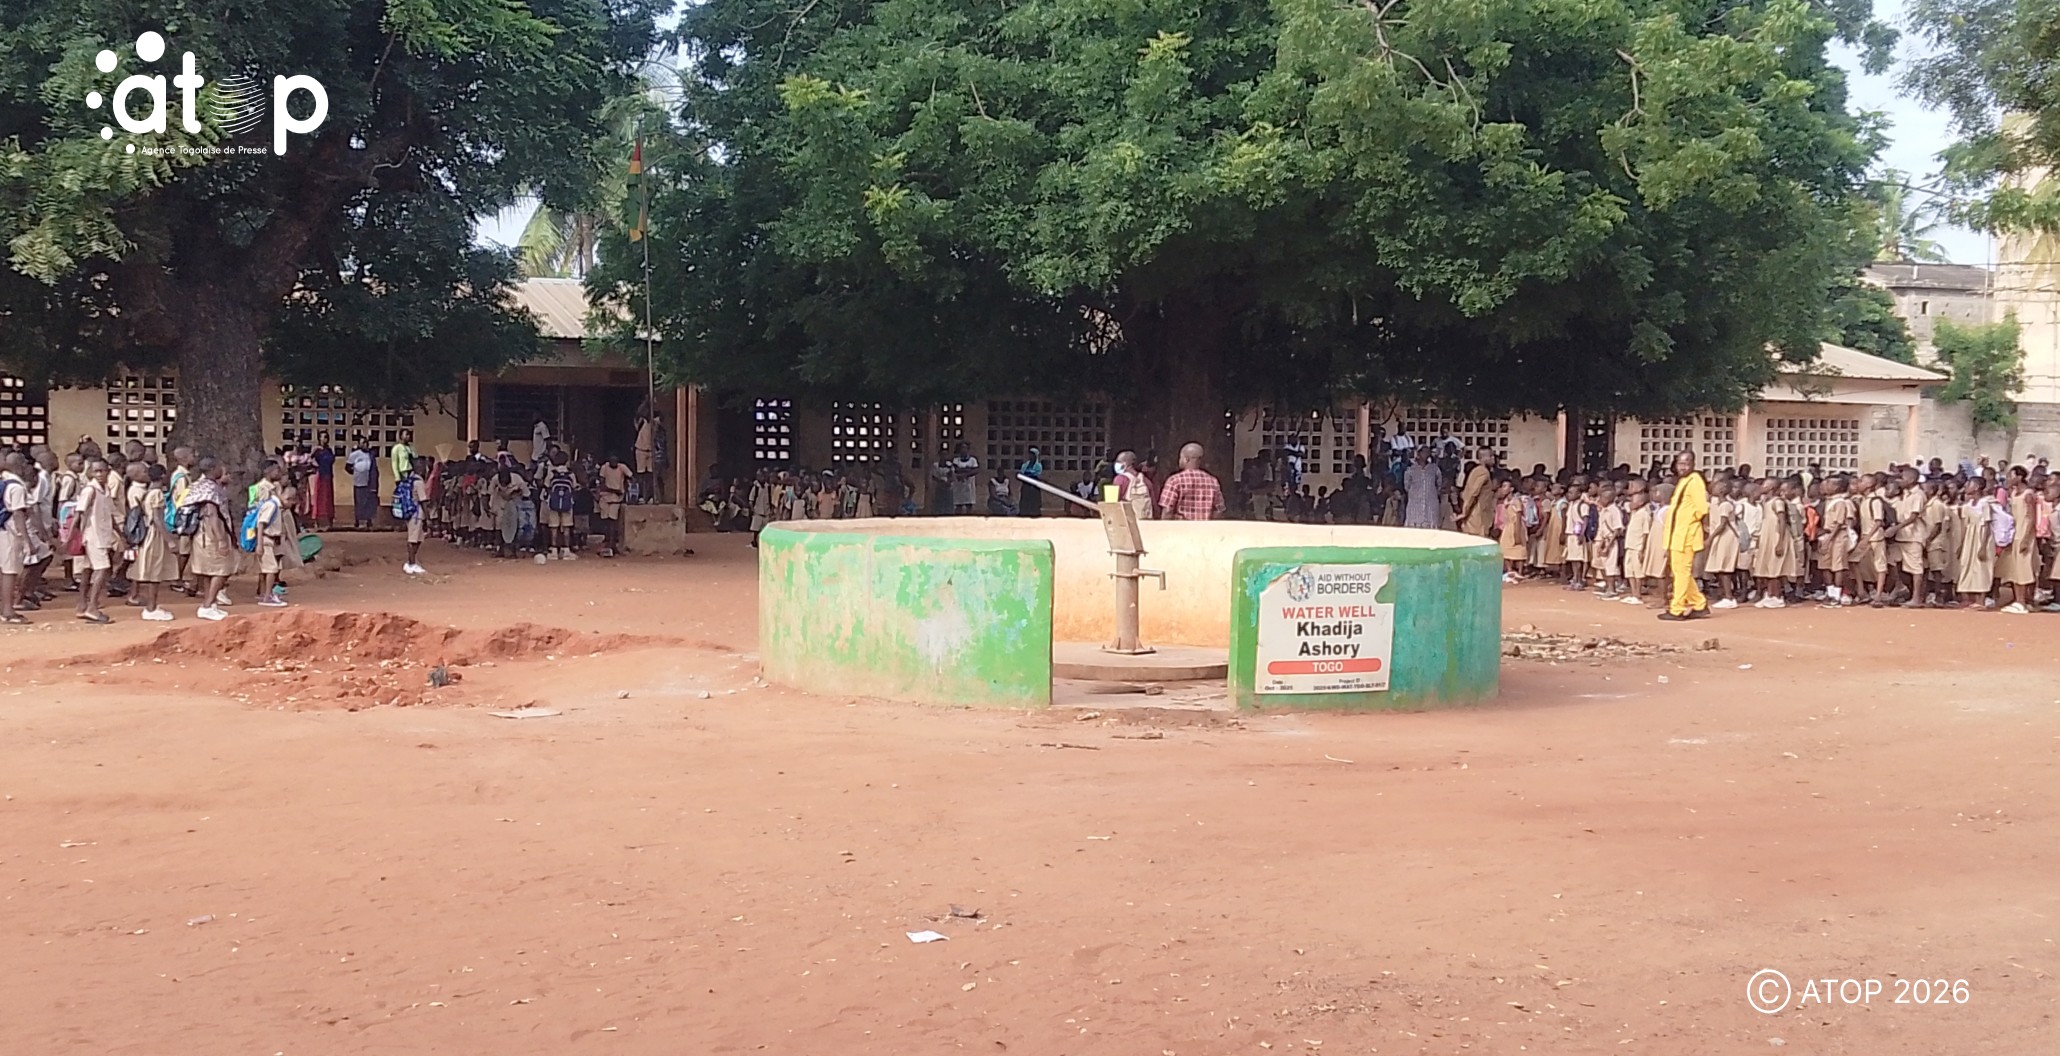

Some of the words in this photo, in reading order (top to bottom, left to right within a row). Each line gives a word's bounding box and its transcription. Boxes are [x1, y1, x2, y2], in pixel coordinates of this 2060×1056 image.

[1317, 573, 1333, 581] AID
[1334, 573, 1371, 581] WITHOUT
[1317, 582, 1371, 594] BORDERS
[1282, 607, 1334, 619] WATER
[1338, 606, 1376, 618] WELL
[1297, 621, 1363, 639] Khadija
[1298, 641, 1360, 658] Ashory
[1312, 662, 1343, 672] TOGO
